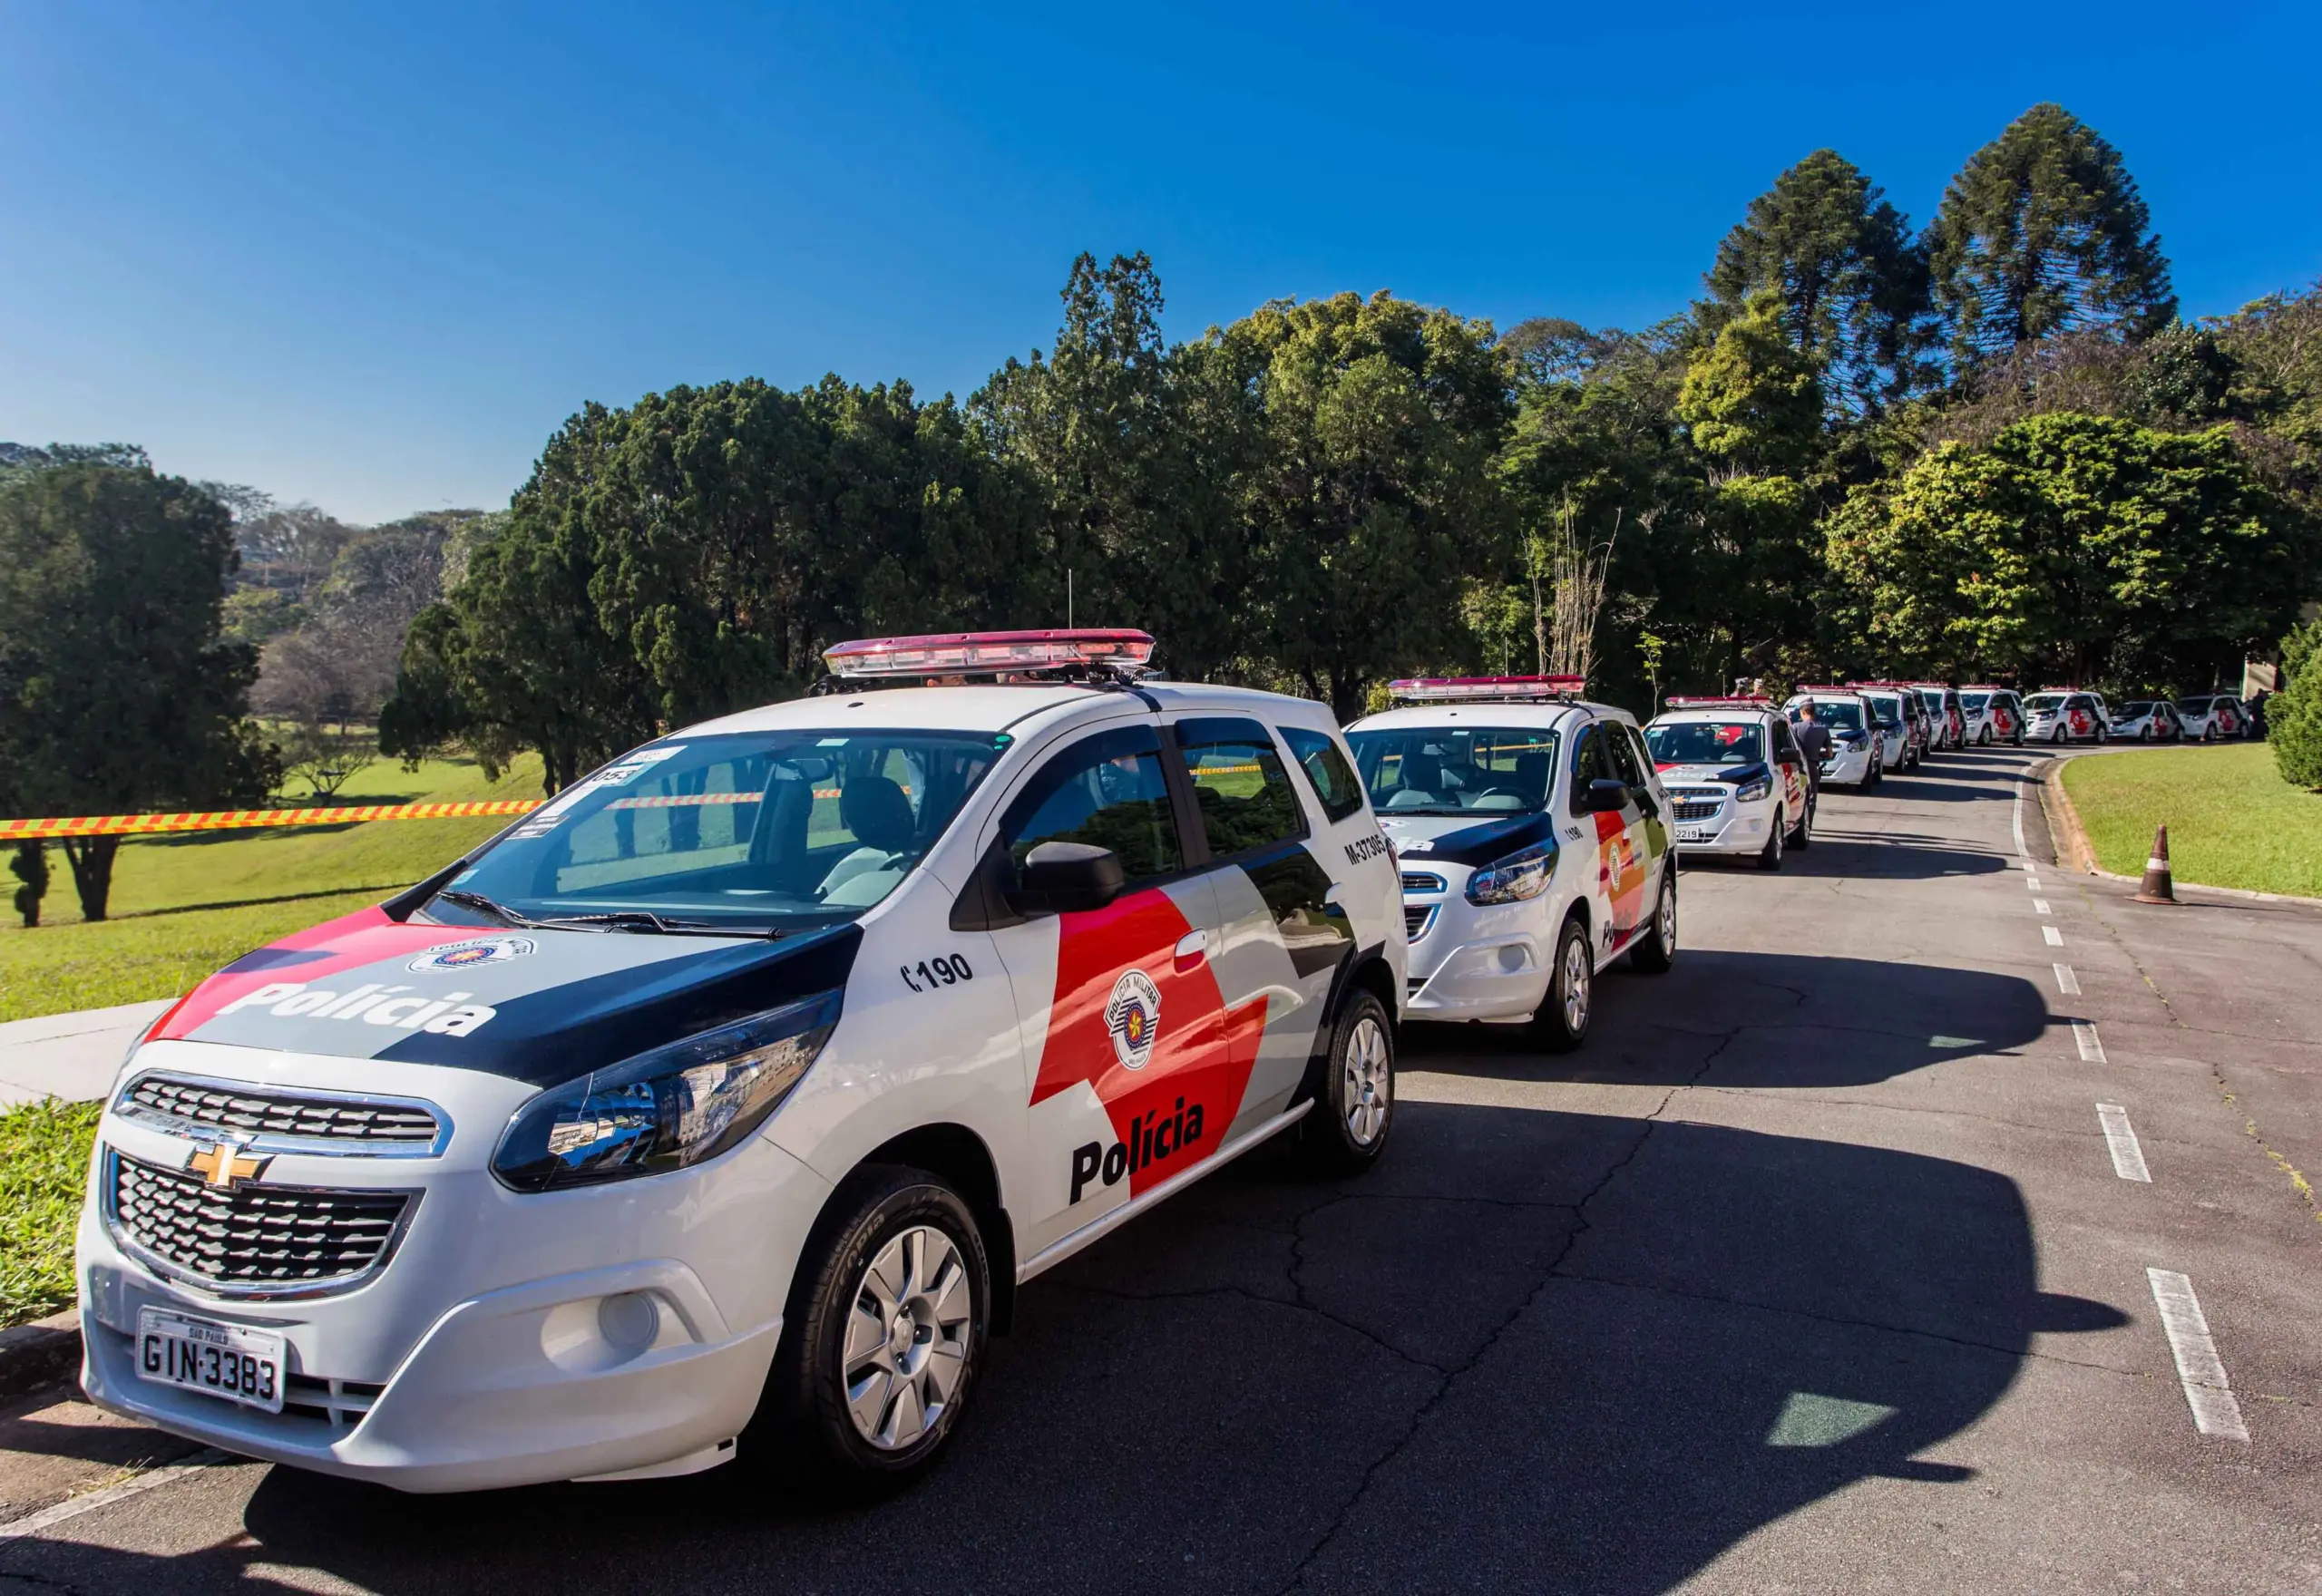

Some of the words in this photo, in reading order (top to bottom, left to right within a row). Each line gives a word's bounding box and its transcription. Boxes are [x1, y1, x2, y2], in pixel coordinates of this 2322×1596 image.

[1343, 833, 1387, 866] M-37305
[916, 952, 973, 989] 190
[214, 983, 497, 1037] Polícia
[1133, 976, 1157, 1007] MILITAR
[1068, 1095, 1205, 1206] Polícia
